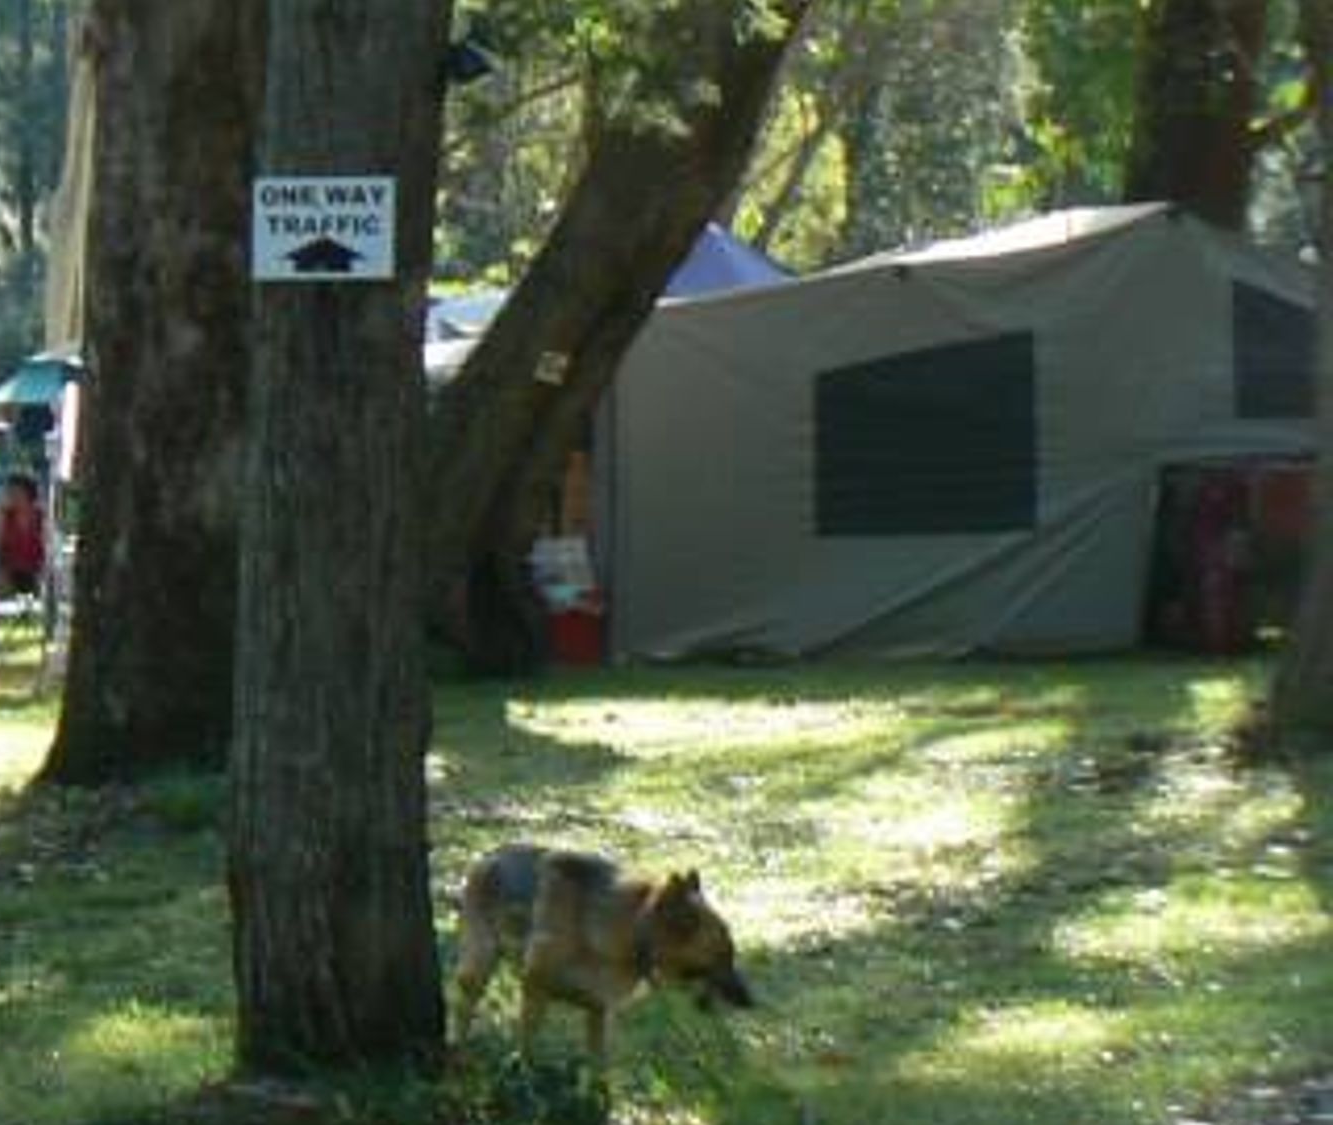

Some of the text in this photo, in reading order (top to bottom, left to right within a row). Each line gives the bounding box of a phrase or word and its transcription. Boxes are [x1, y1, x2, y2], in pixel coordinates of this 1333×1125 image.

[261, 185, 384, 206] ONE WAY
[267, 214, 381, 235] TRAFFIC
